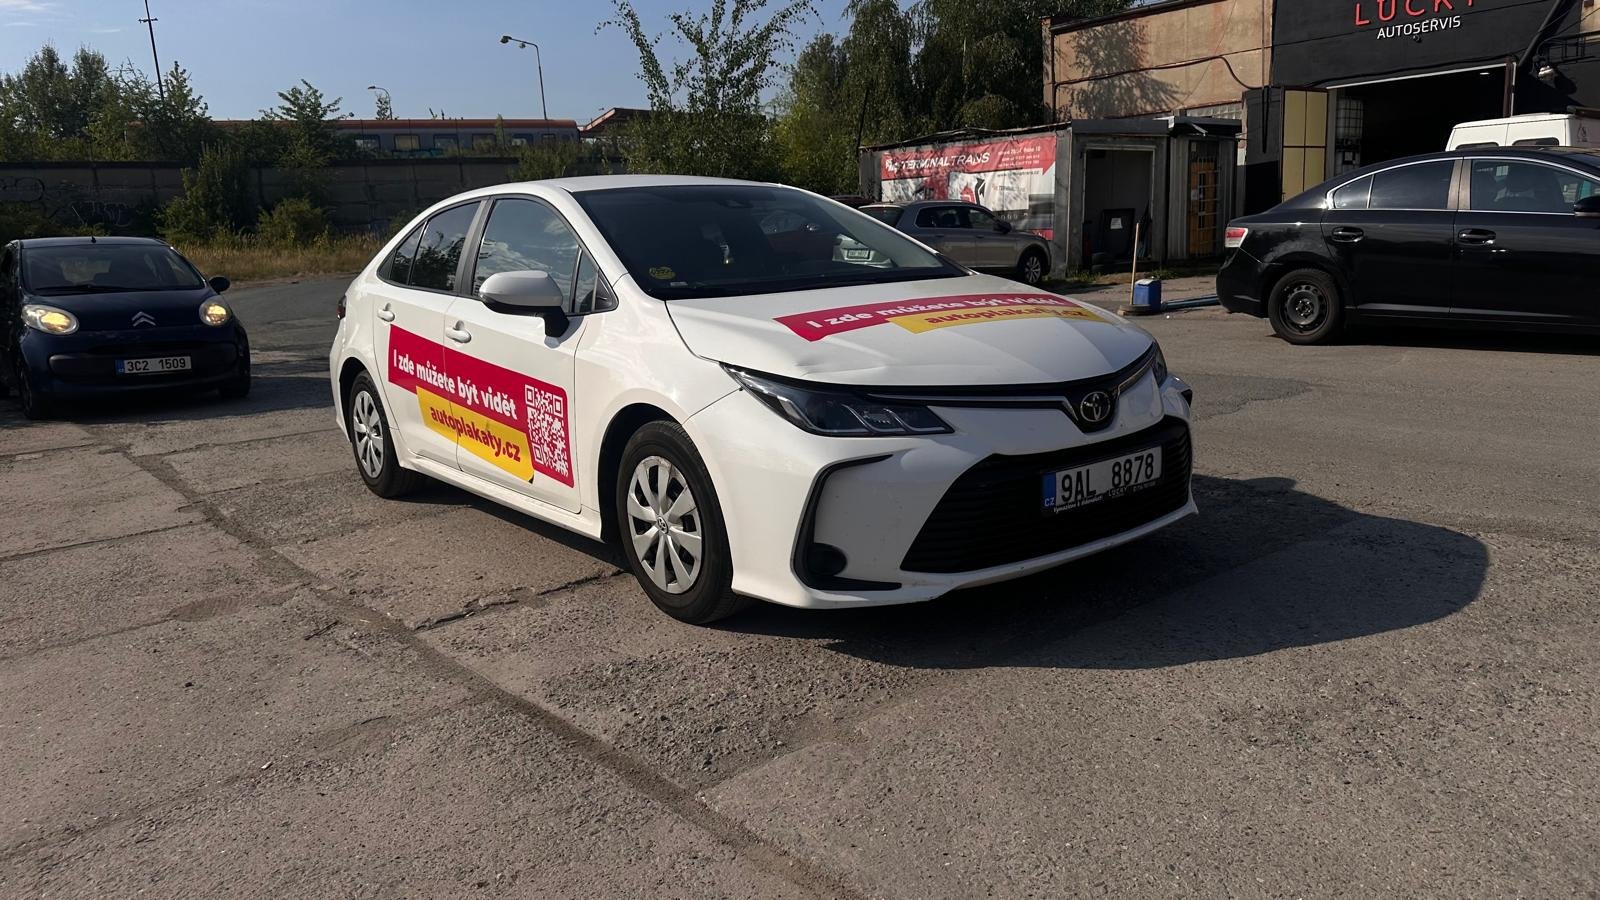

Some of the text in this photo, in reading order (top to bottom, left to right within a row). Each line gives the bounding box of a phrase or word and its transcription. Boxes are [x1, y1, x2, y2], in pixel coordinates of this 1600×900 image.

[1355, 0, 1474, 26] LUCK
[1376, 15, 1461, 39] AUTOSERVIS
[806, 320, 823, 328] I
[824, 312, 873, 325] zde
[127, 360, 150, 372] 3C2
[158, 357, 186, 370] 1509
[393, 349, 518, 420] I zde můžete být vidět
[429, 406, 522, 463] autoplakaty.cz
[1061, 468, 1097, 502] 9AL
[1111, 453, 1154, 489] 8878
[1044, 497, 1055, 507] CZ
